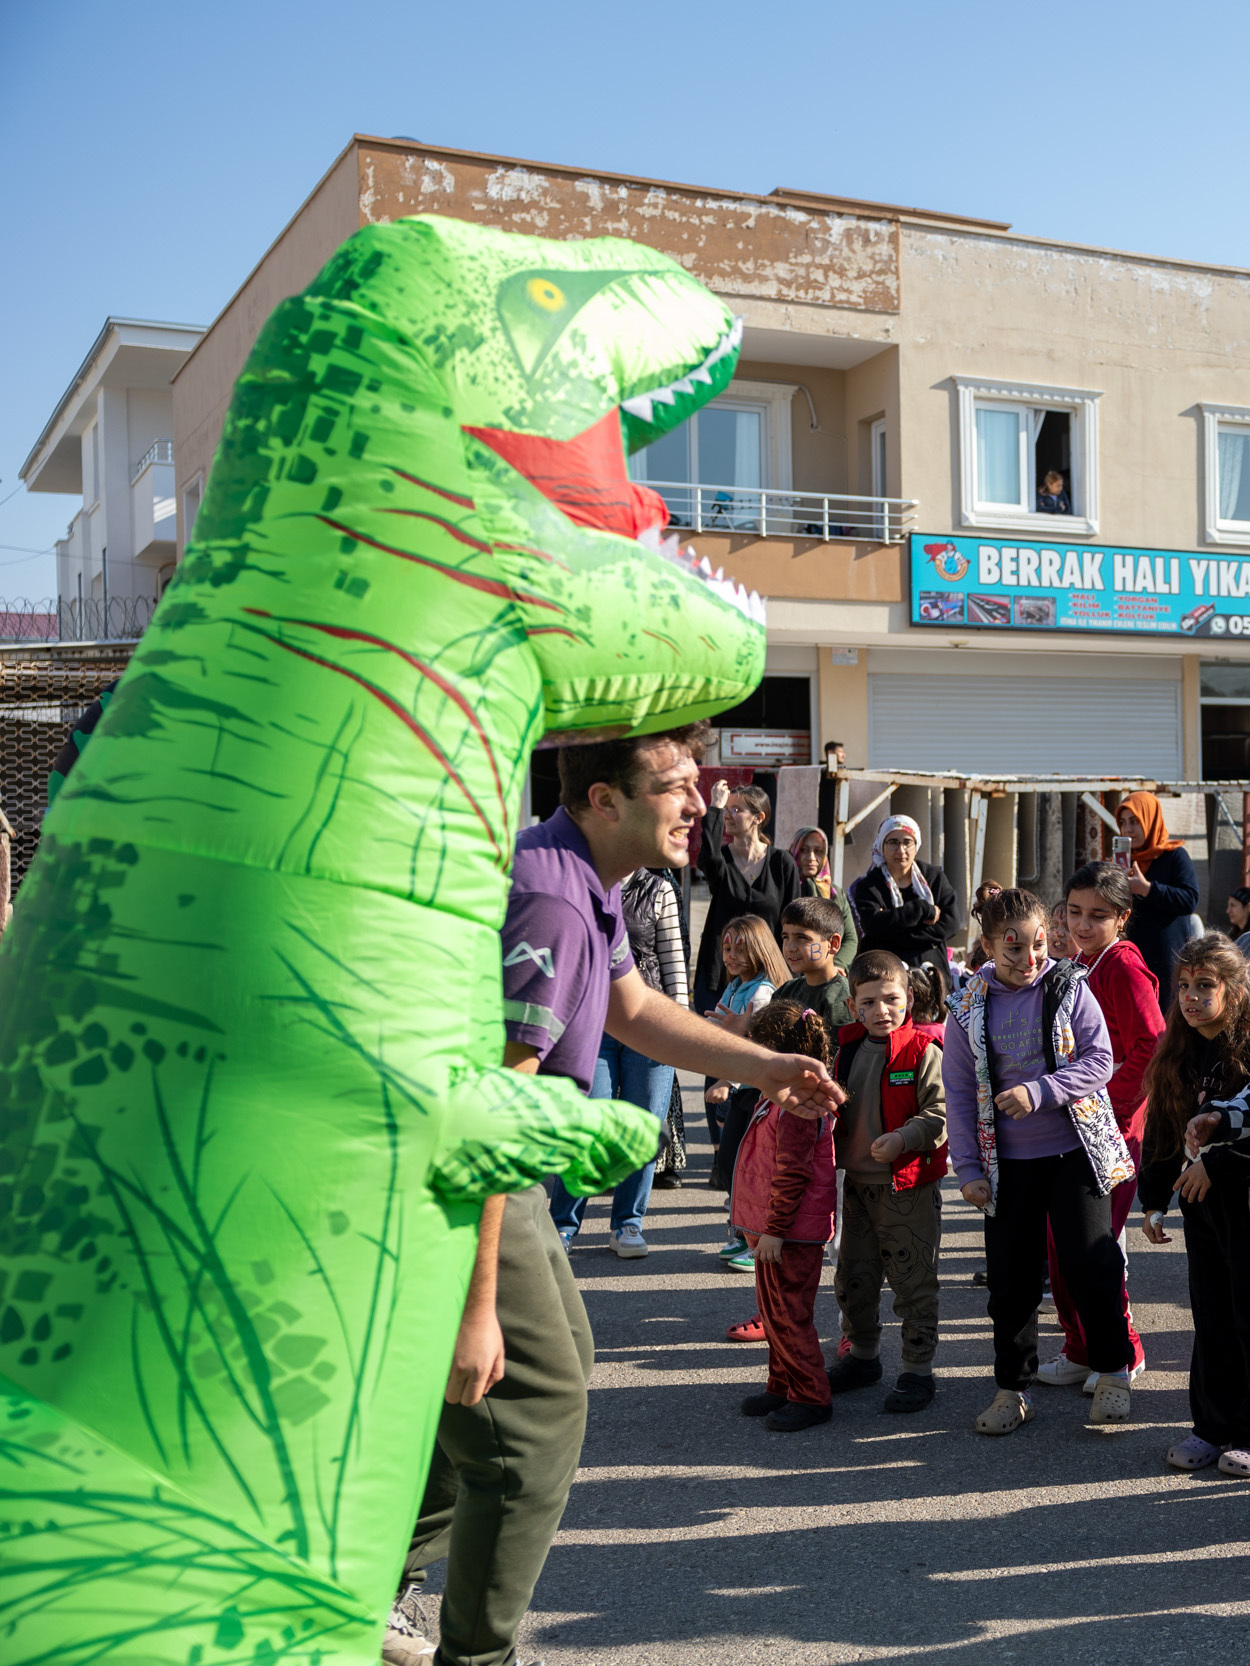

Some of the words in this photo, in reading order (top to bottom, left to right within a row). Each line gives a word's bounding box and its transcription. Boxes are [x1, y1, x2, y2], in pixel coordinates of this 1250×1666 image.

[978, 545, 1105, 591] BERRAK
[1113, 553, 1180, 595] HALI
[1072, 593, 1096, 601] HALI
[1073, 610, 1111, 618] YOLLUK
[1118, 612, 1156, 620] KOLTUK
[810, 943, 822, 961] B
[1001, 1009, 1027, 1030] it's
[993, 1029, 1031, 1041] beautiful
[1001, 1042, 1016, 1051] GO
[1019, 1037, 1043, 1047] AFTE
[1016, 1049, 1038, 1057] YOUR
